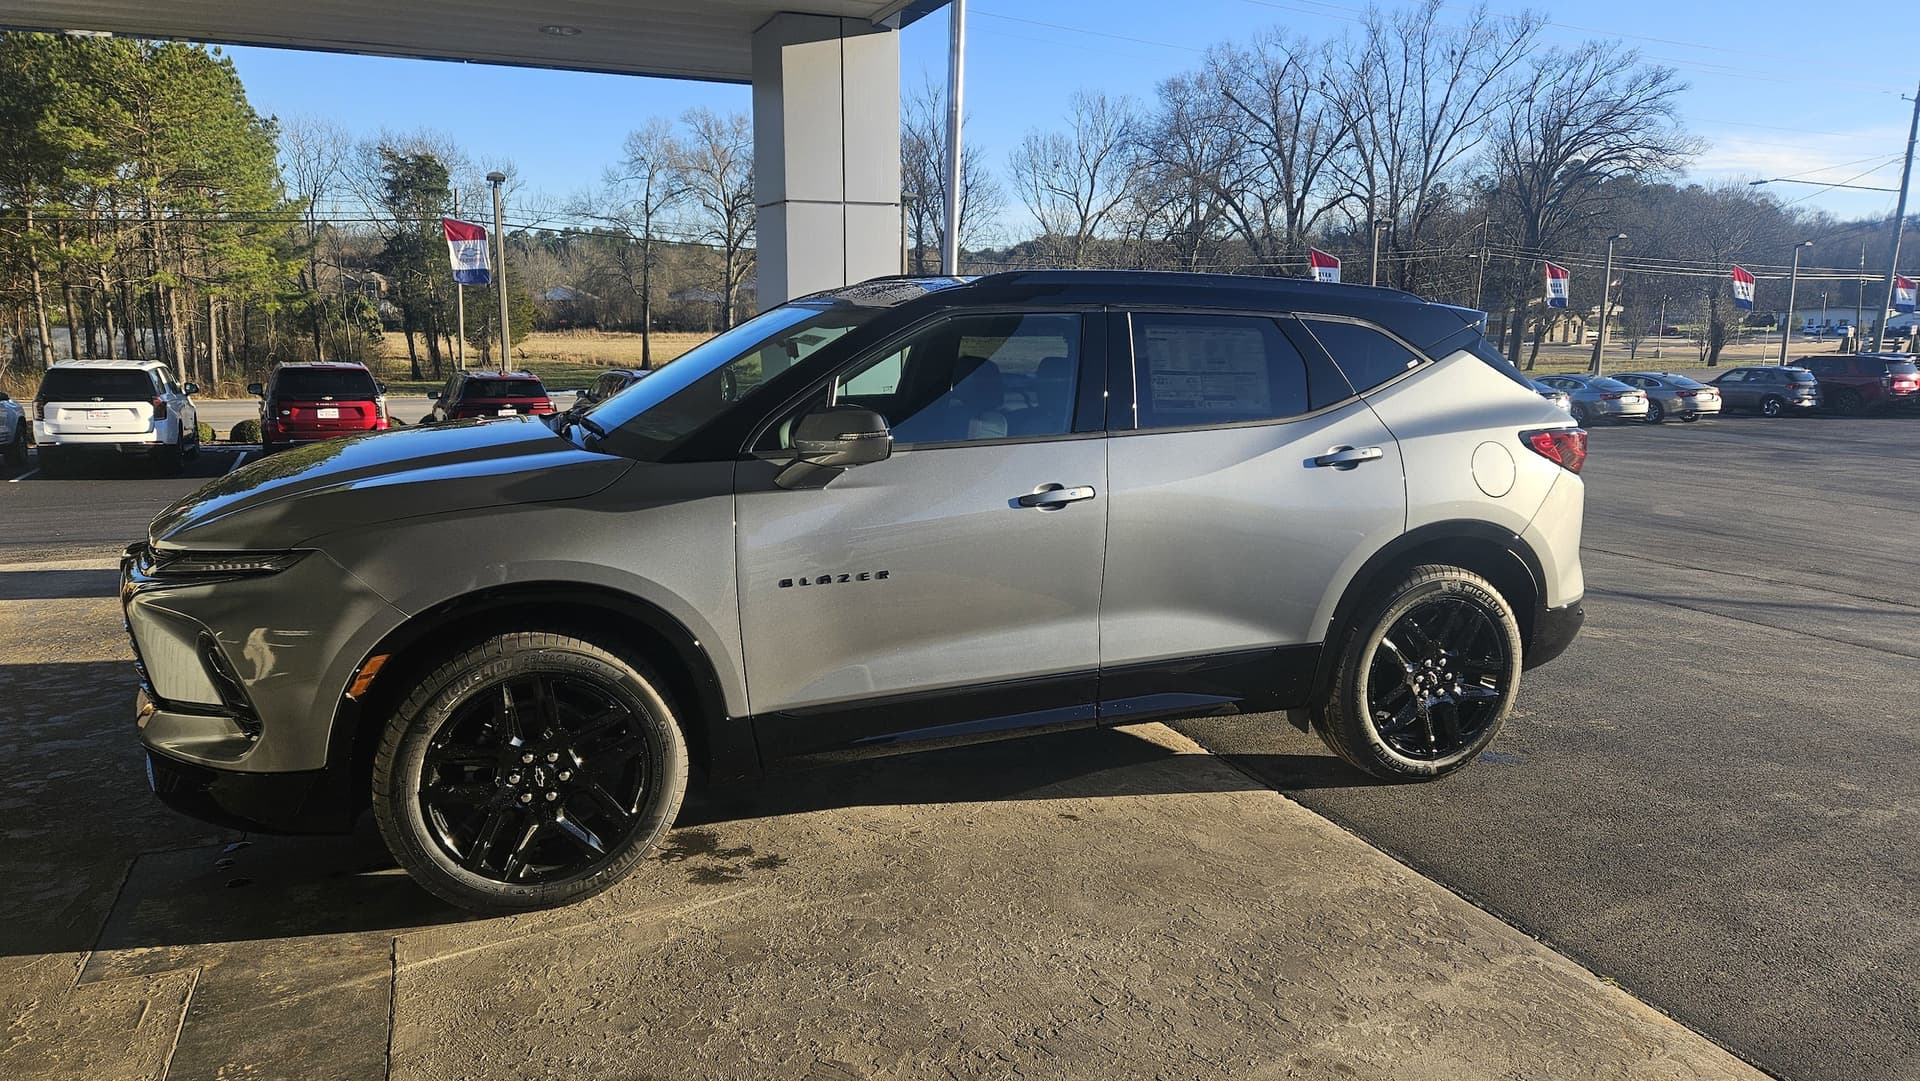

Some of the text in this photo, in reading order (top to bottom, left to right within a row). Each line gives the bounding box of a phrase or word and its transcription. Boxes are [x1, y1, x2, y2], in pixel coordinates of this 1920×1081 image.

[778, 570, 890, 588] BLAZER
[1463, 585, 1505, 617] MICHELIN
[574, 656, 601, 670] TOUR
